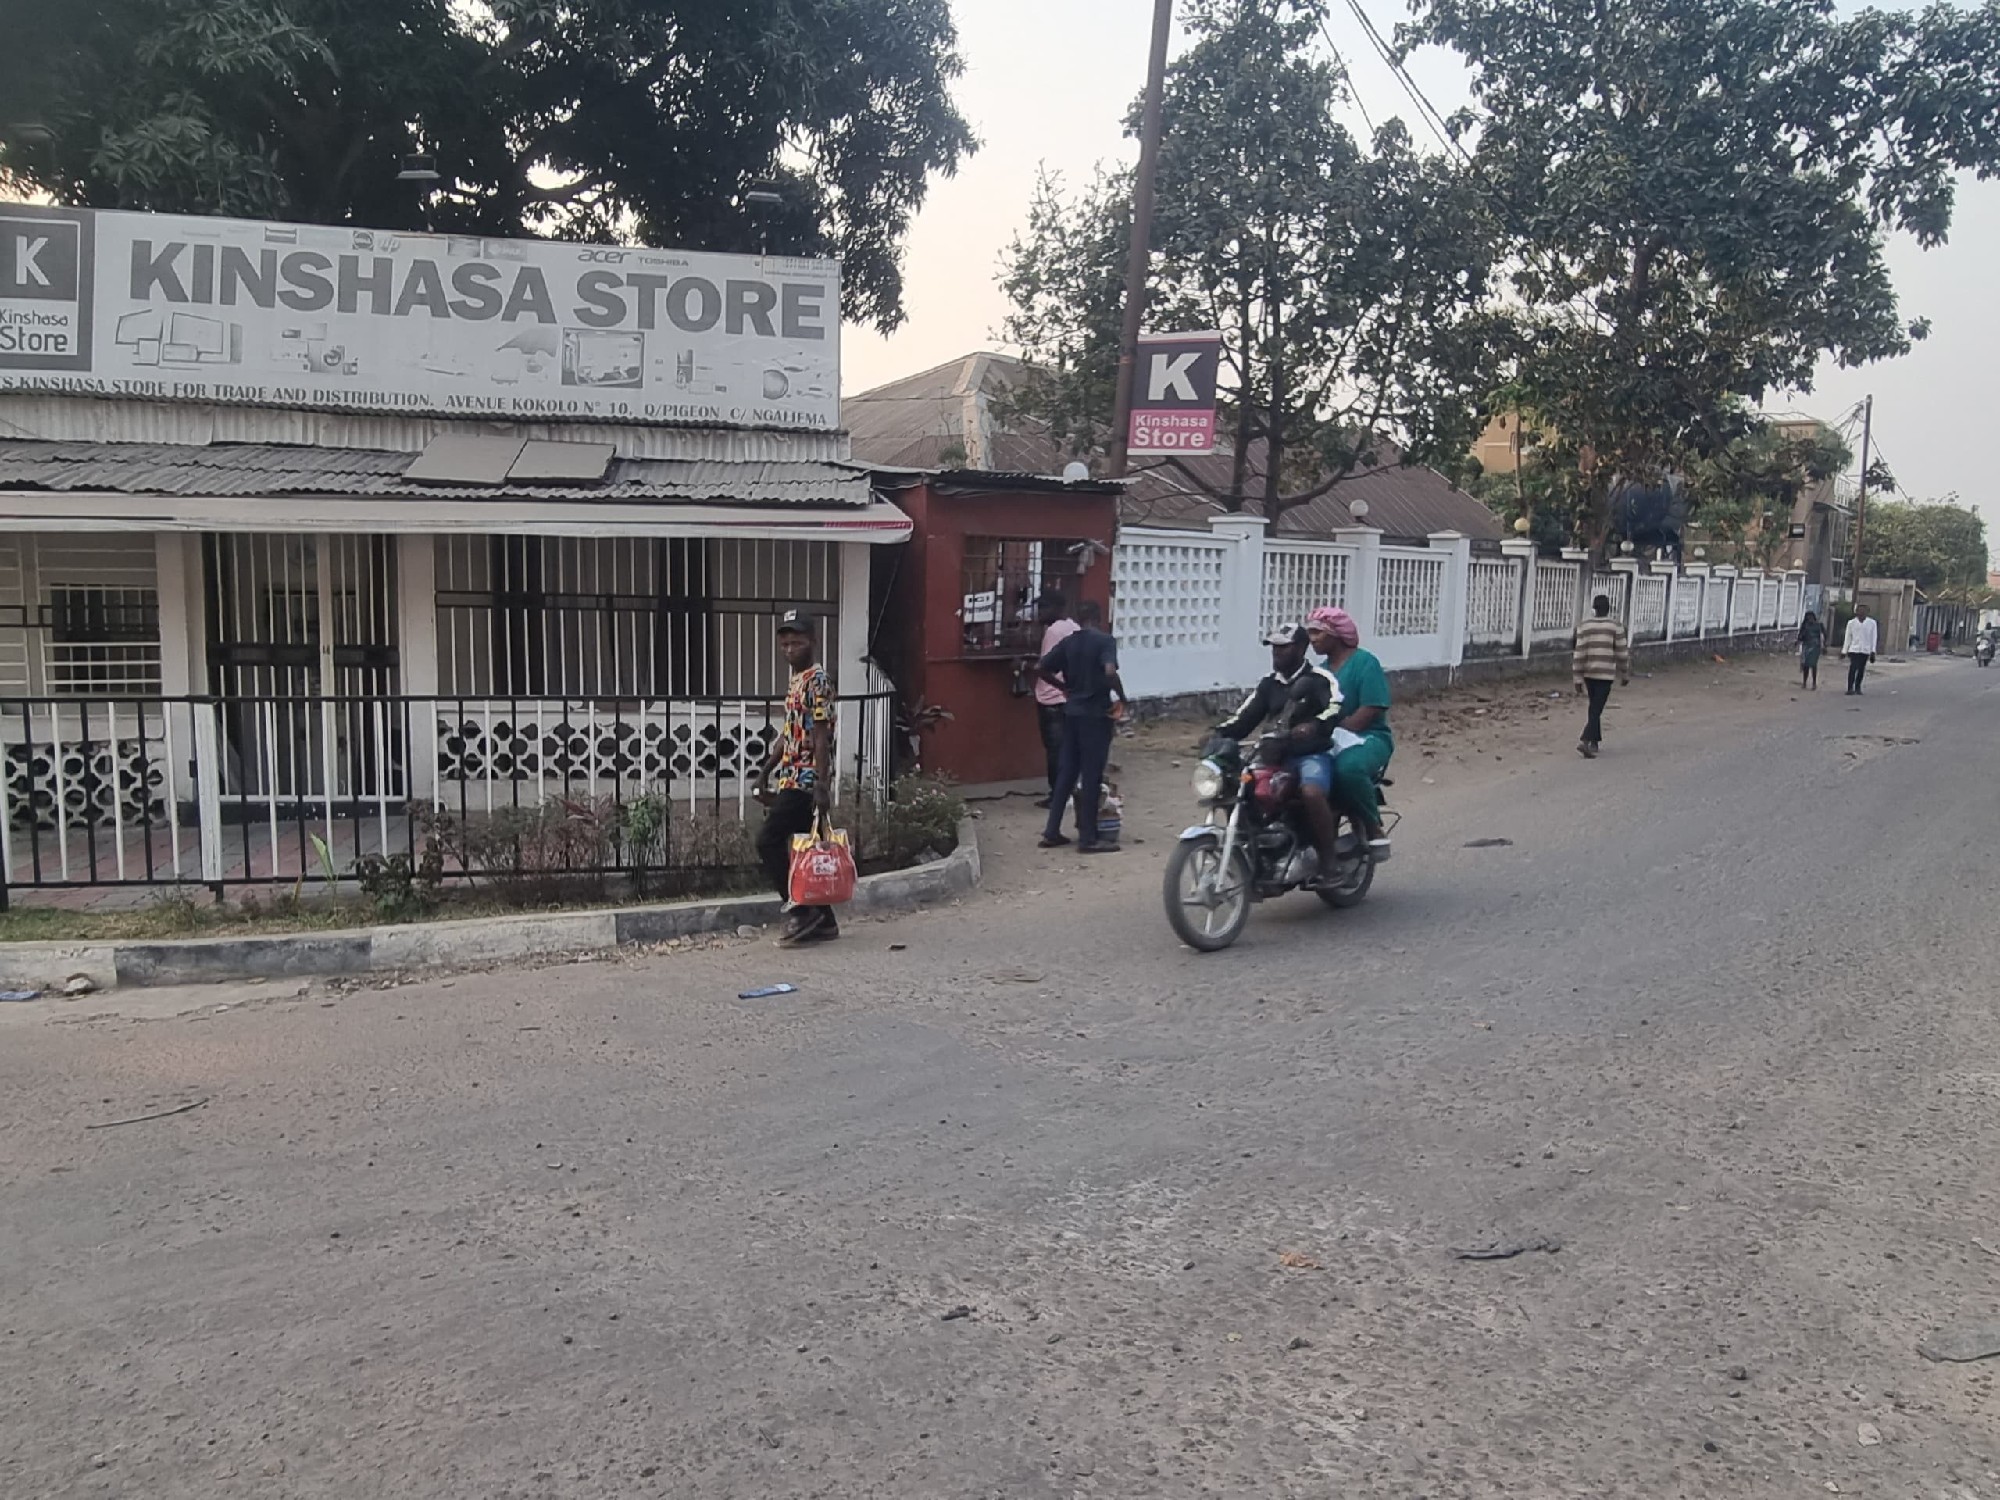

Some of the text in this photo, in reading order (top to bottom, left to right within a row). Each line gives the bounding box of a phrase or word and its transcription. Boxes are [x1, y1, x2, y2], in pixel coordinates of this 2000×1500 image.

[15, 235, 51, 286] K
[578, 249, 632, 264] acer
[638, 256, 689, 267] TOSHIBA
[130, 239, 826, 340] KINSHASA STORE
[0, 308, 69, 327] Kinshasa
[0, 325, 69, 353] Store
[1148, 352, 1203, 401] K
[20, 376, 105, 393] KINSHASA
[112, 379, 168, 395] STORE
[173, 382, 206, 398] FOR
[213, 384, 267, 399] TRADE
[272, 387, 307, 401] AND
[313, 389, 435, 407] DISTRIBUTION.
[445, 394, 506, 410] AVENUE
[512, 398, 578, 413] KOKOLO
[730, 408, 746, 420] C/
[752, 409, 827, 426] NGALIEMA
[1135, 415, 1208, 427] Kinshasa
[1134, 427, 1205, 447] Store
